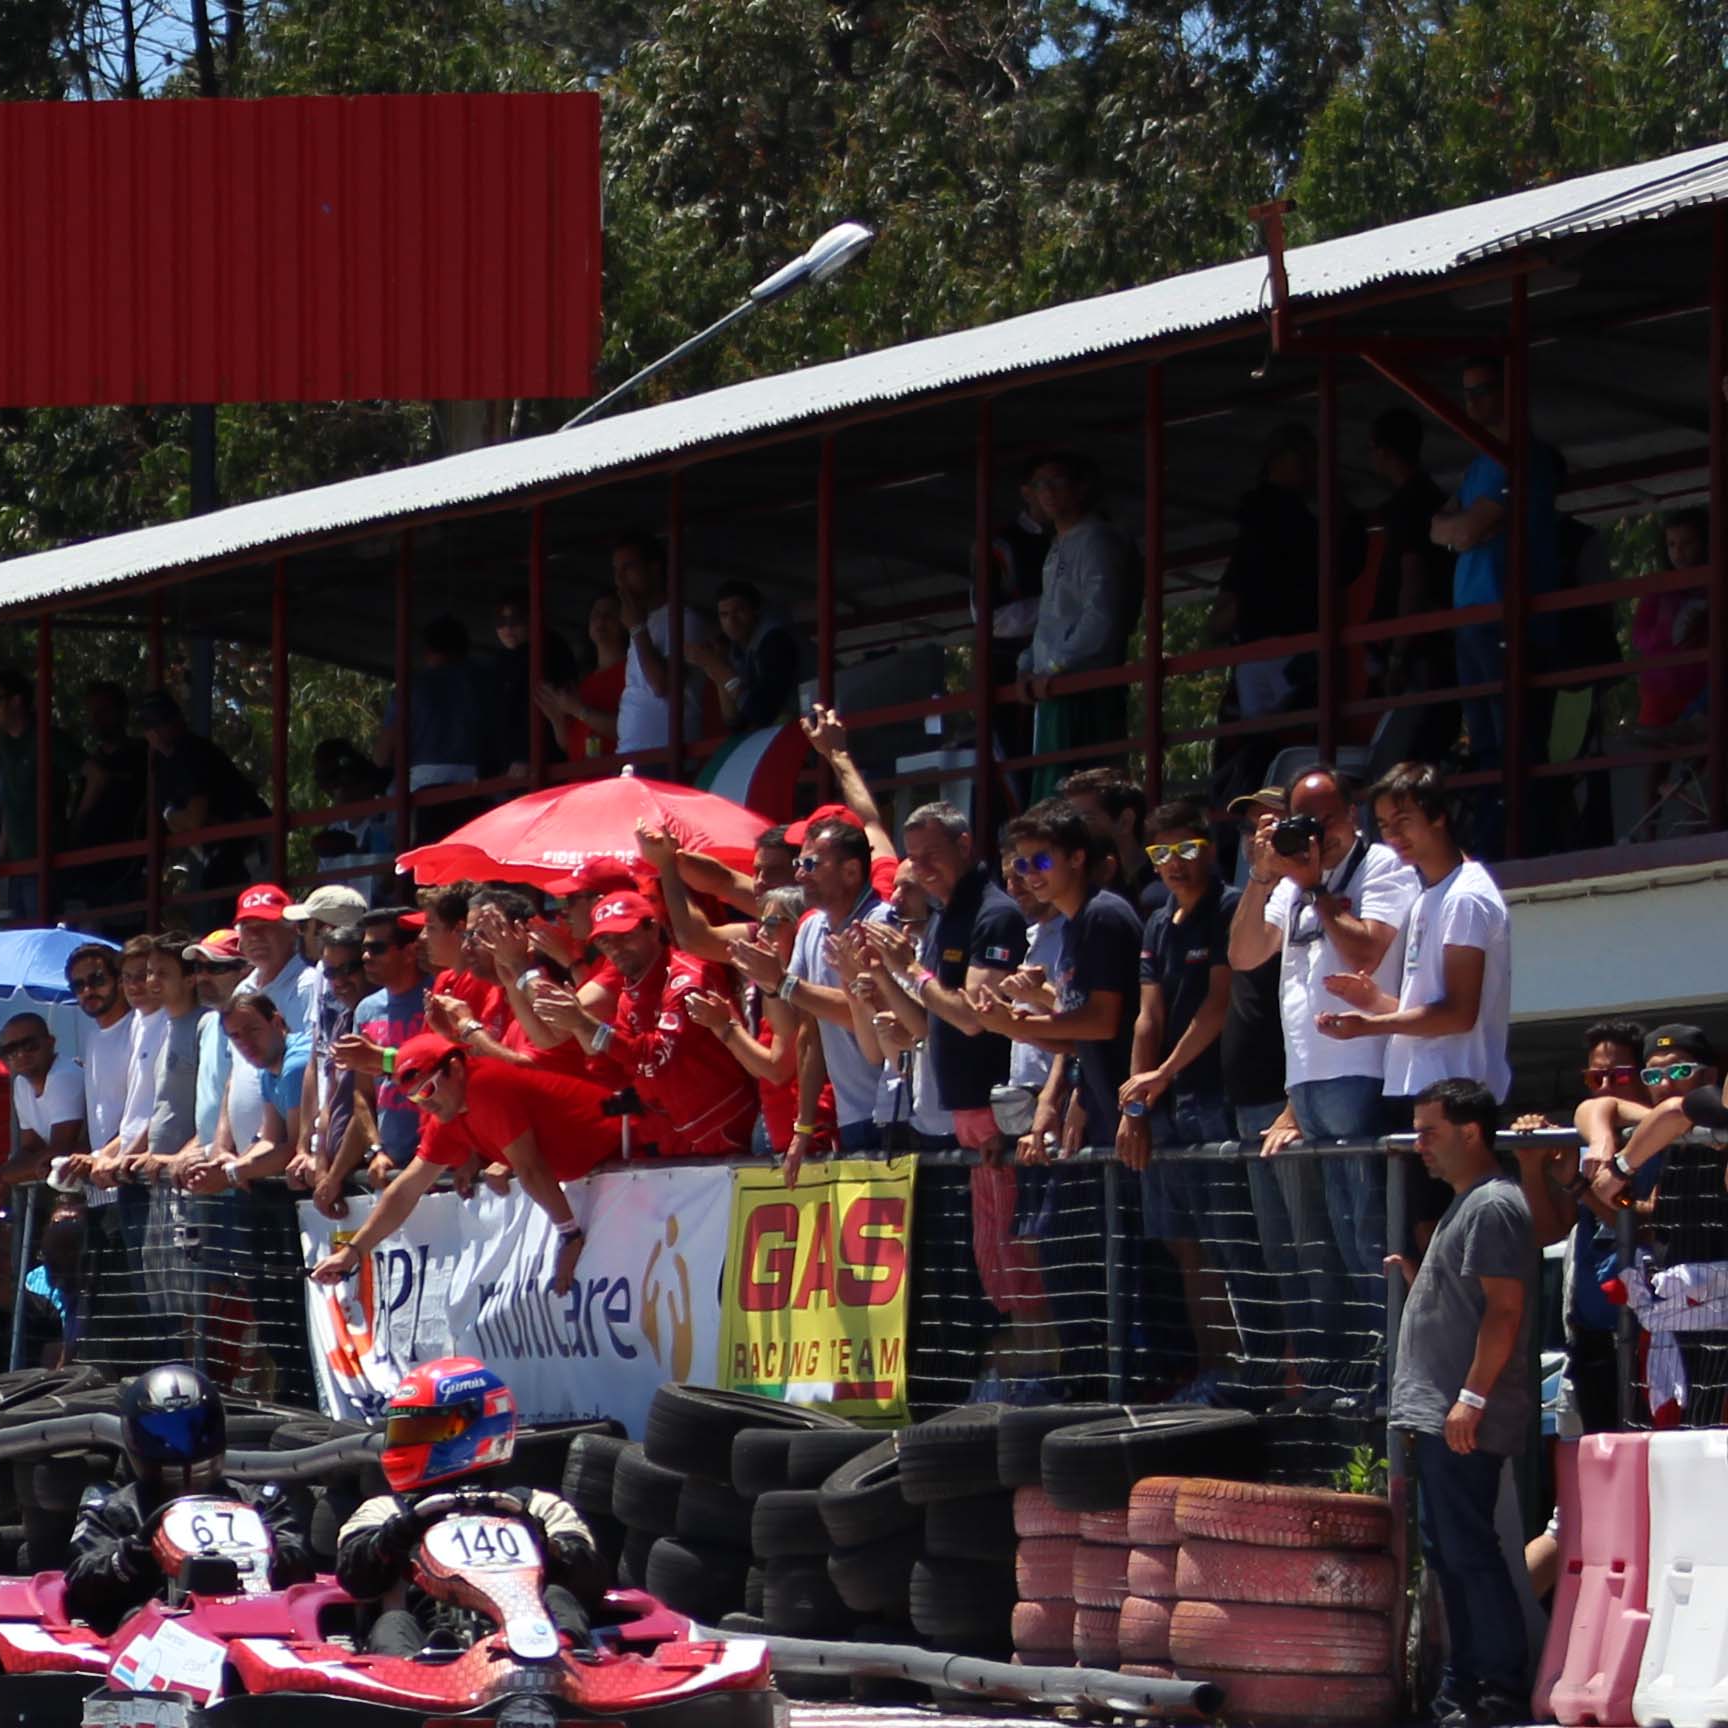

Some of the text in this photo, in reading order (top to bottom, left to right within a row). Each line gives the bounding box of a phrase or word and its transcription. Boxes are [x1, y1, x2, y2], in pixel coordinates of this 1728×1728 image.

[738, 1196, 907, 1312] GAS
[475, 1275, 638, 1360] multicare
[733, 1337, 901, 1379] RACING TEAM
[191, 1512, 234, 1545] 67
[451, 1525, 520, 1561] 140
